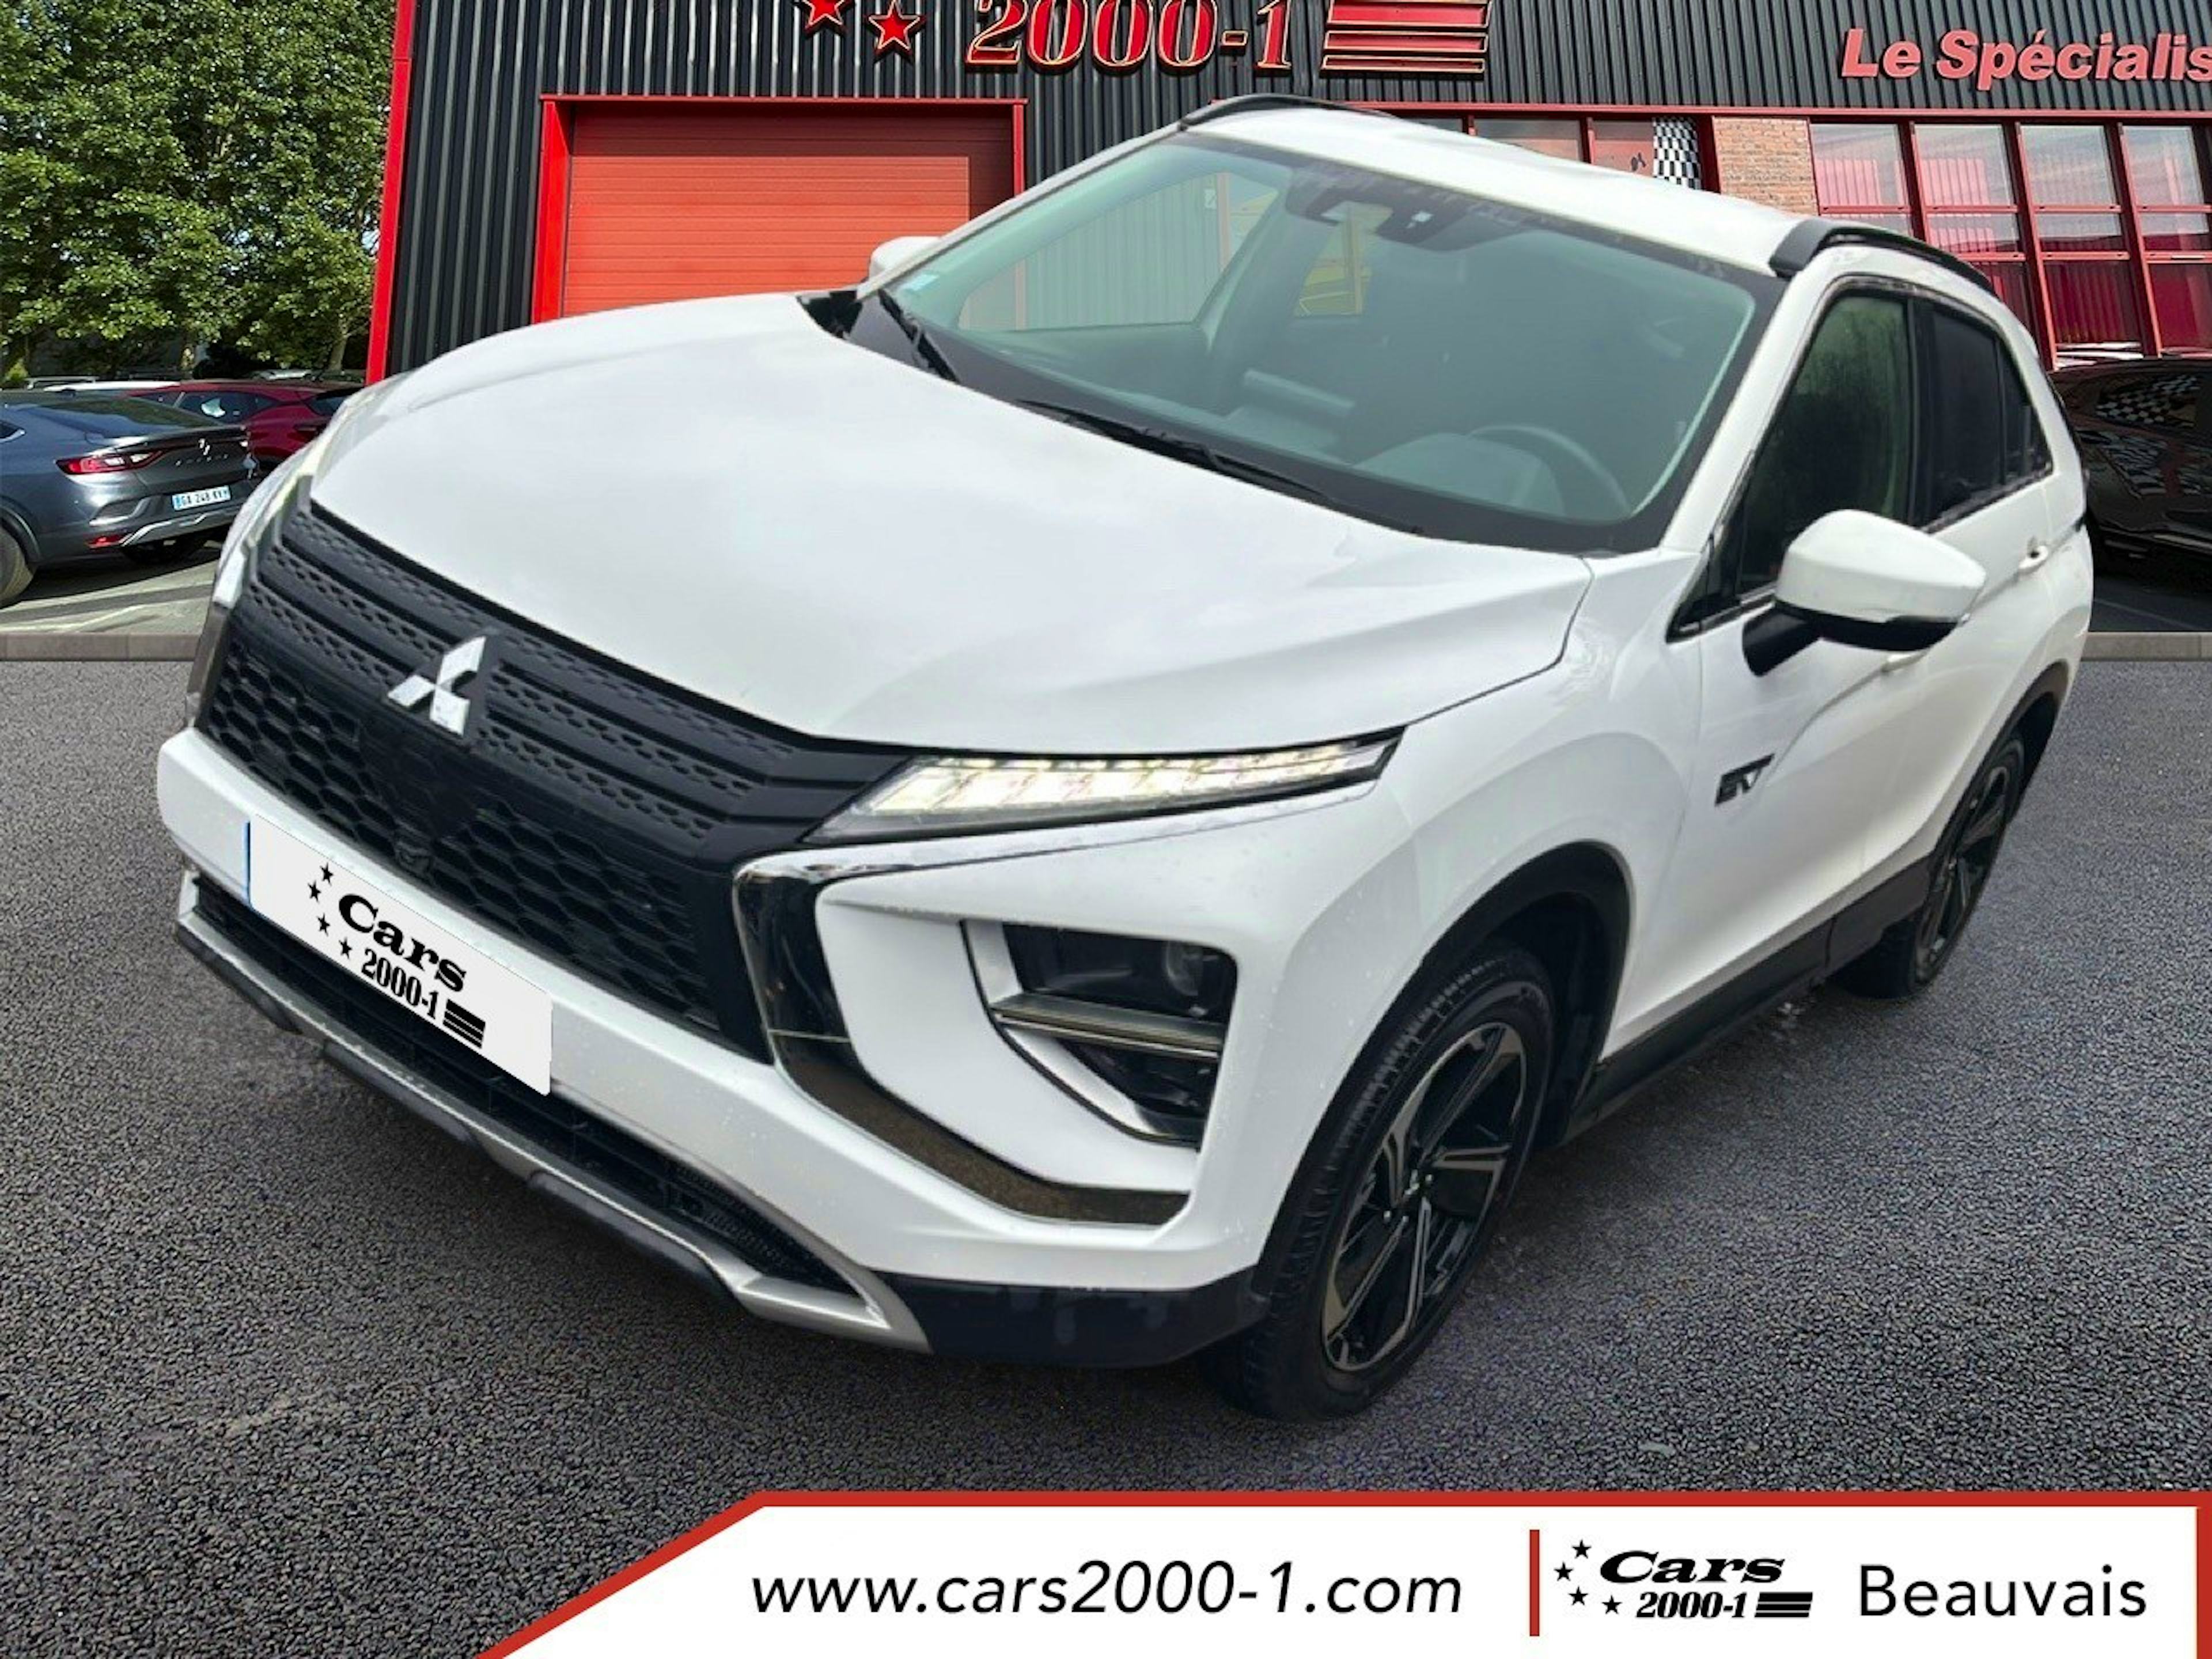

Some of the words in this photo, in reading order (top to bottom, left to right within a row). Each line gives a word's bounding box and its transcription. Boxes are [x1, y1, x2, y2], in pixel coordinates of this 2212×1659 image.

[965, 0, 1292, 69] 2000-1
[1842, 29, 1921, 78] Le
[1937, 29, 2212, 90] Spécialis
